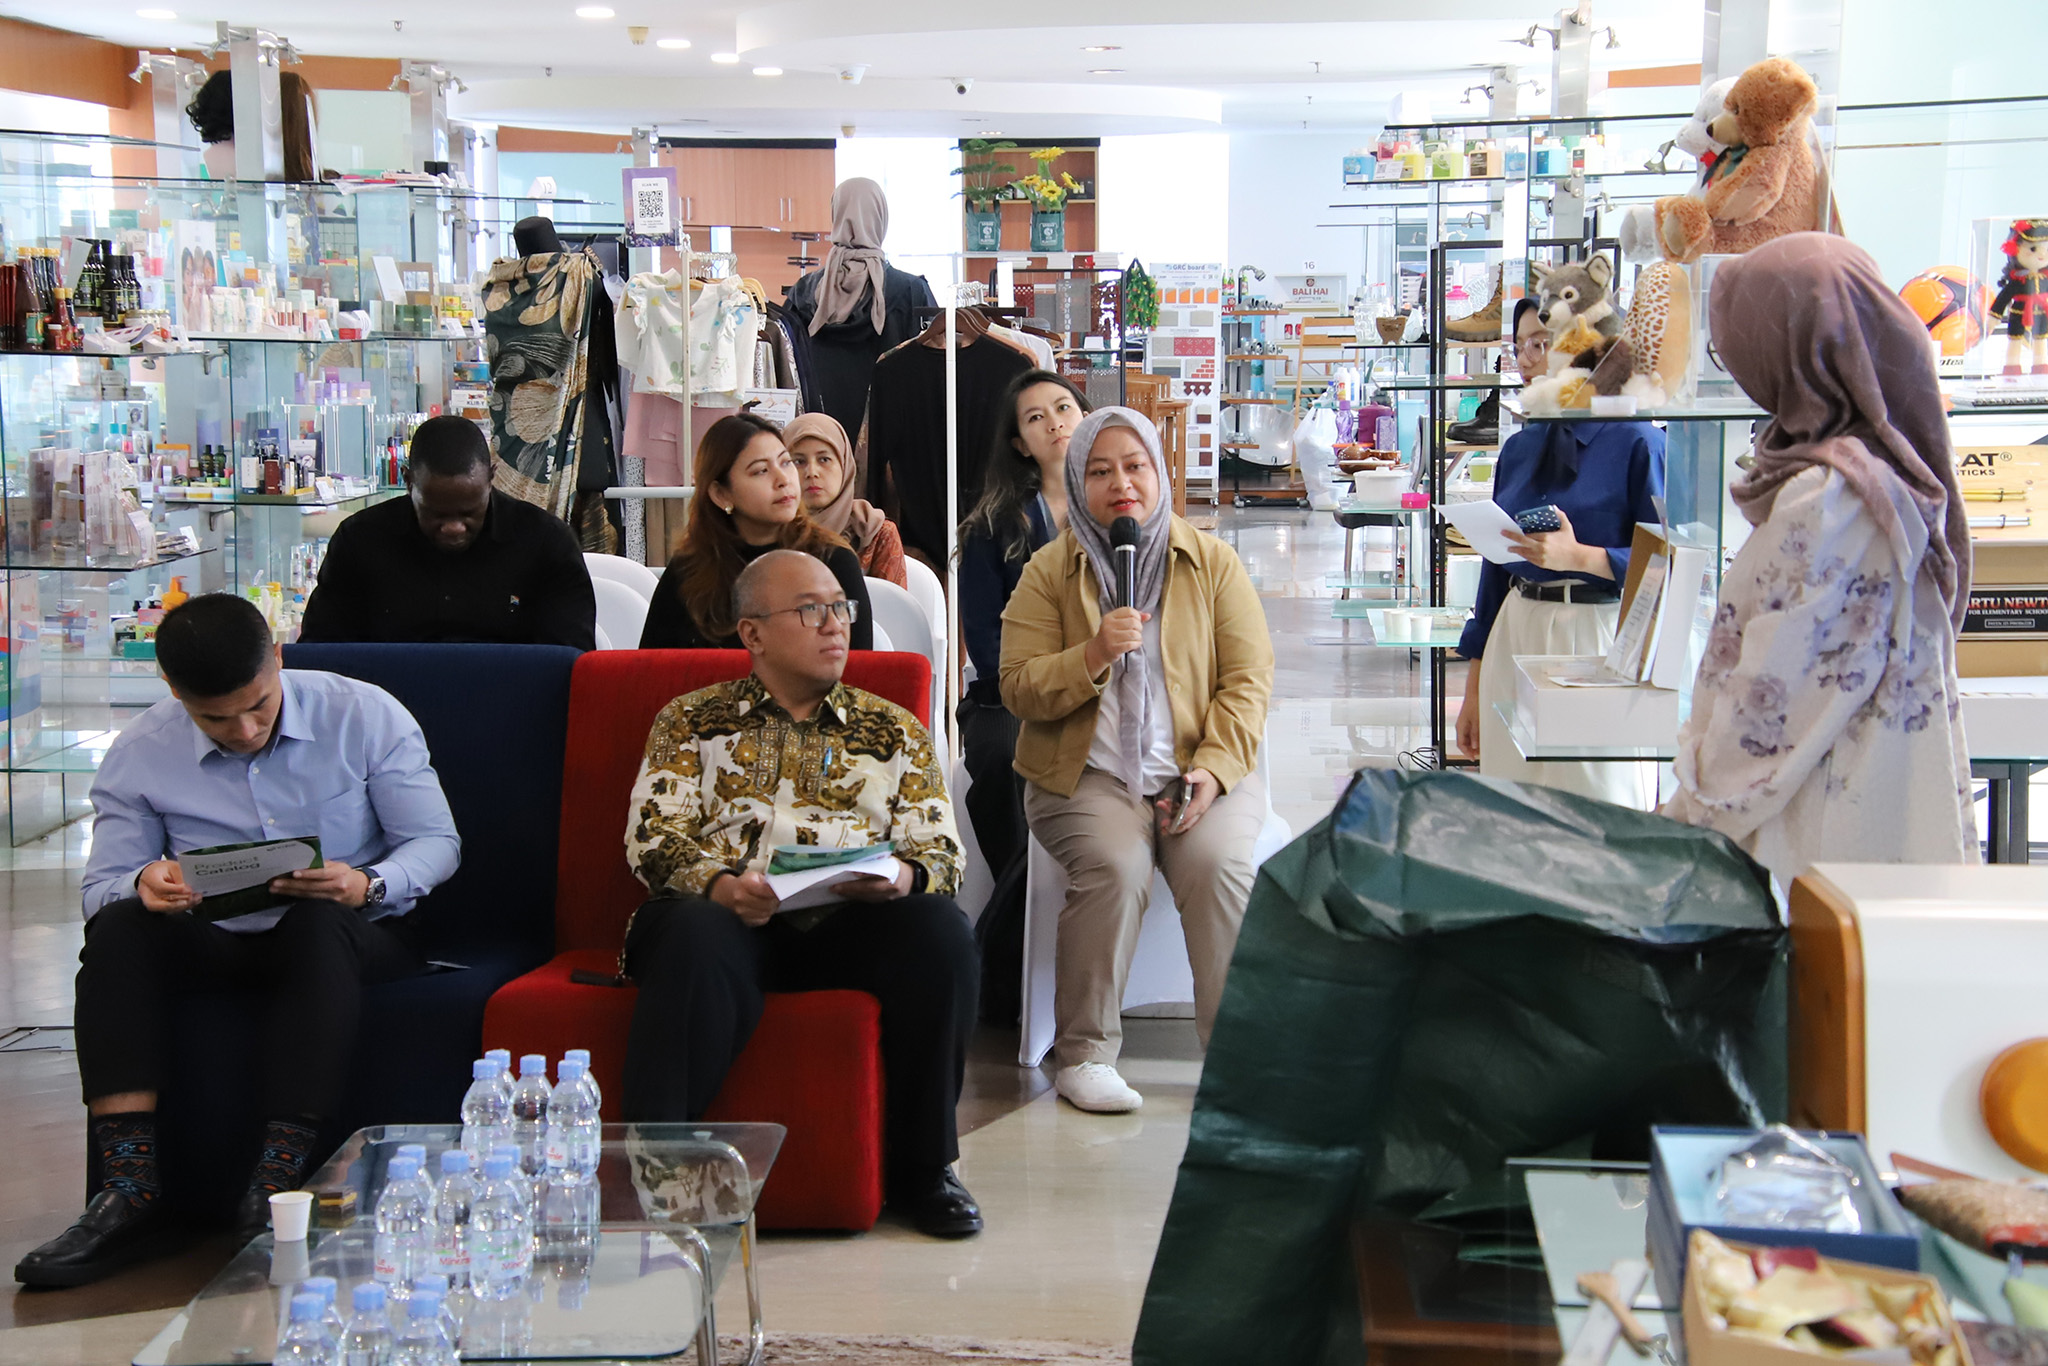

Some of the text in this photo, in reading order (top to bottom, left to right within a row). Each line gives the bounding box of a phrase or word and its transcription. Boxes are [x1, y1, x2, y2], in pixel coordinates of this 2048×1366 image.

[542, 182, 552, 194] 12
[1304, 261, 1315, 270] 16
[1292, 288, 1329, 296] BALI HAI
[1969, 597, 2048, 609] RTU NEWT
[194, 856, 258, 870] Product
[195, 862, 260, 876] Catalog
